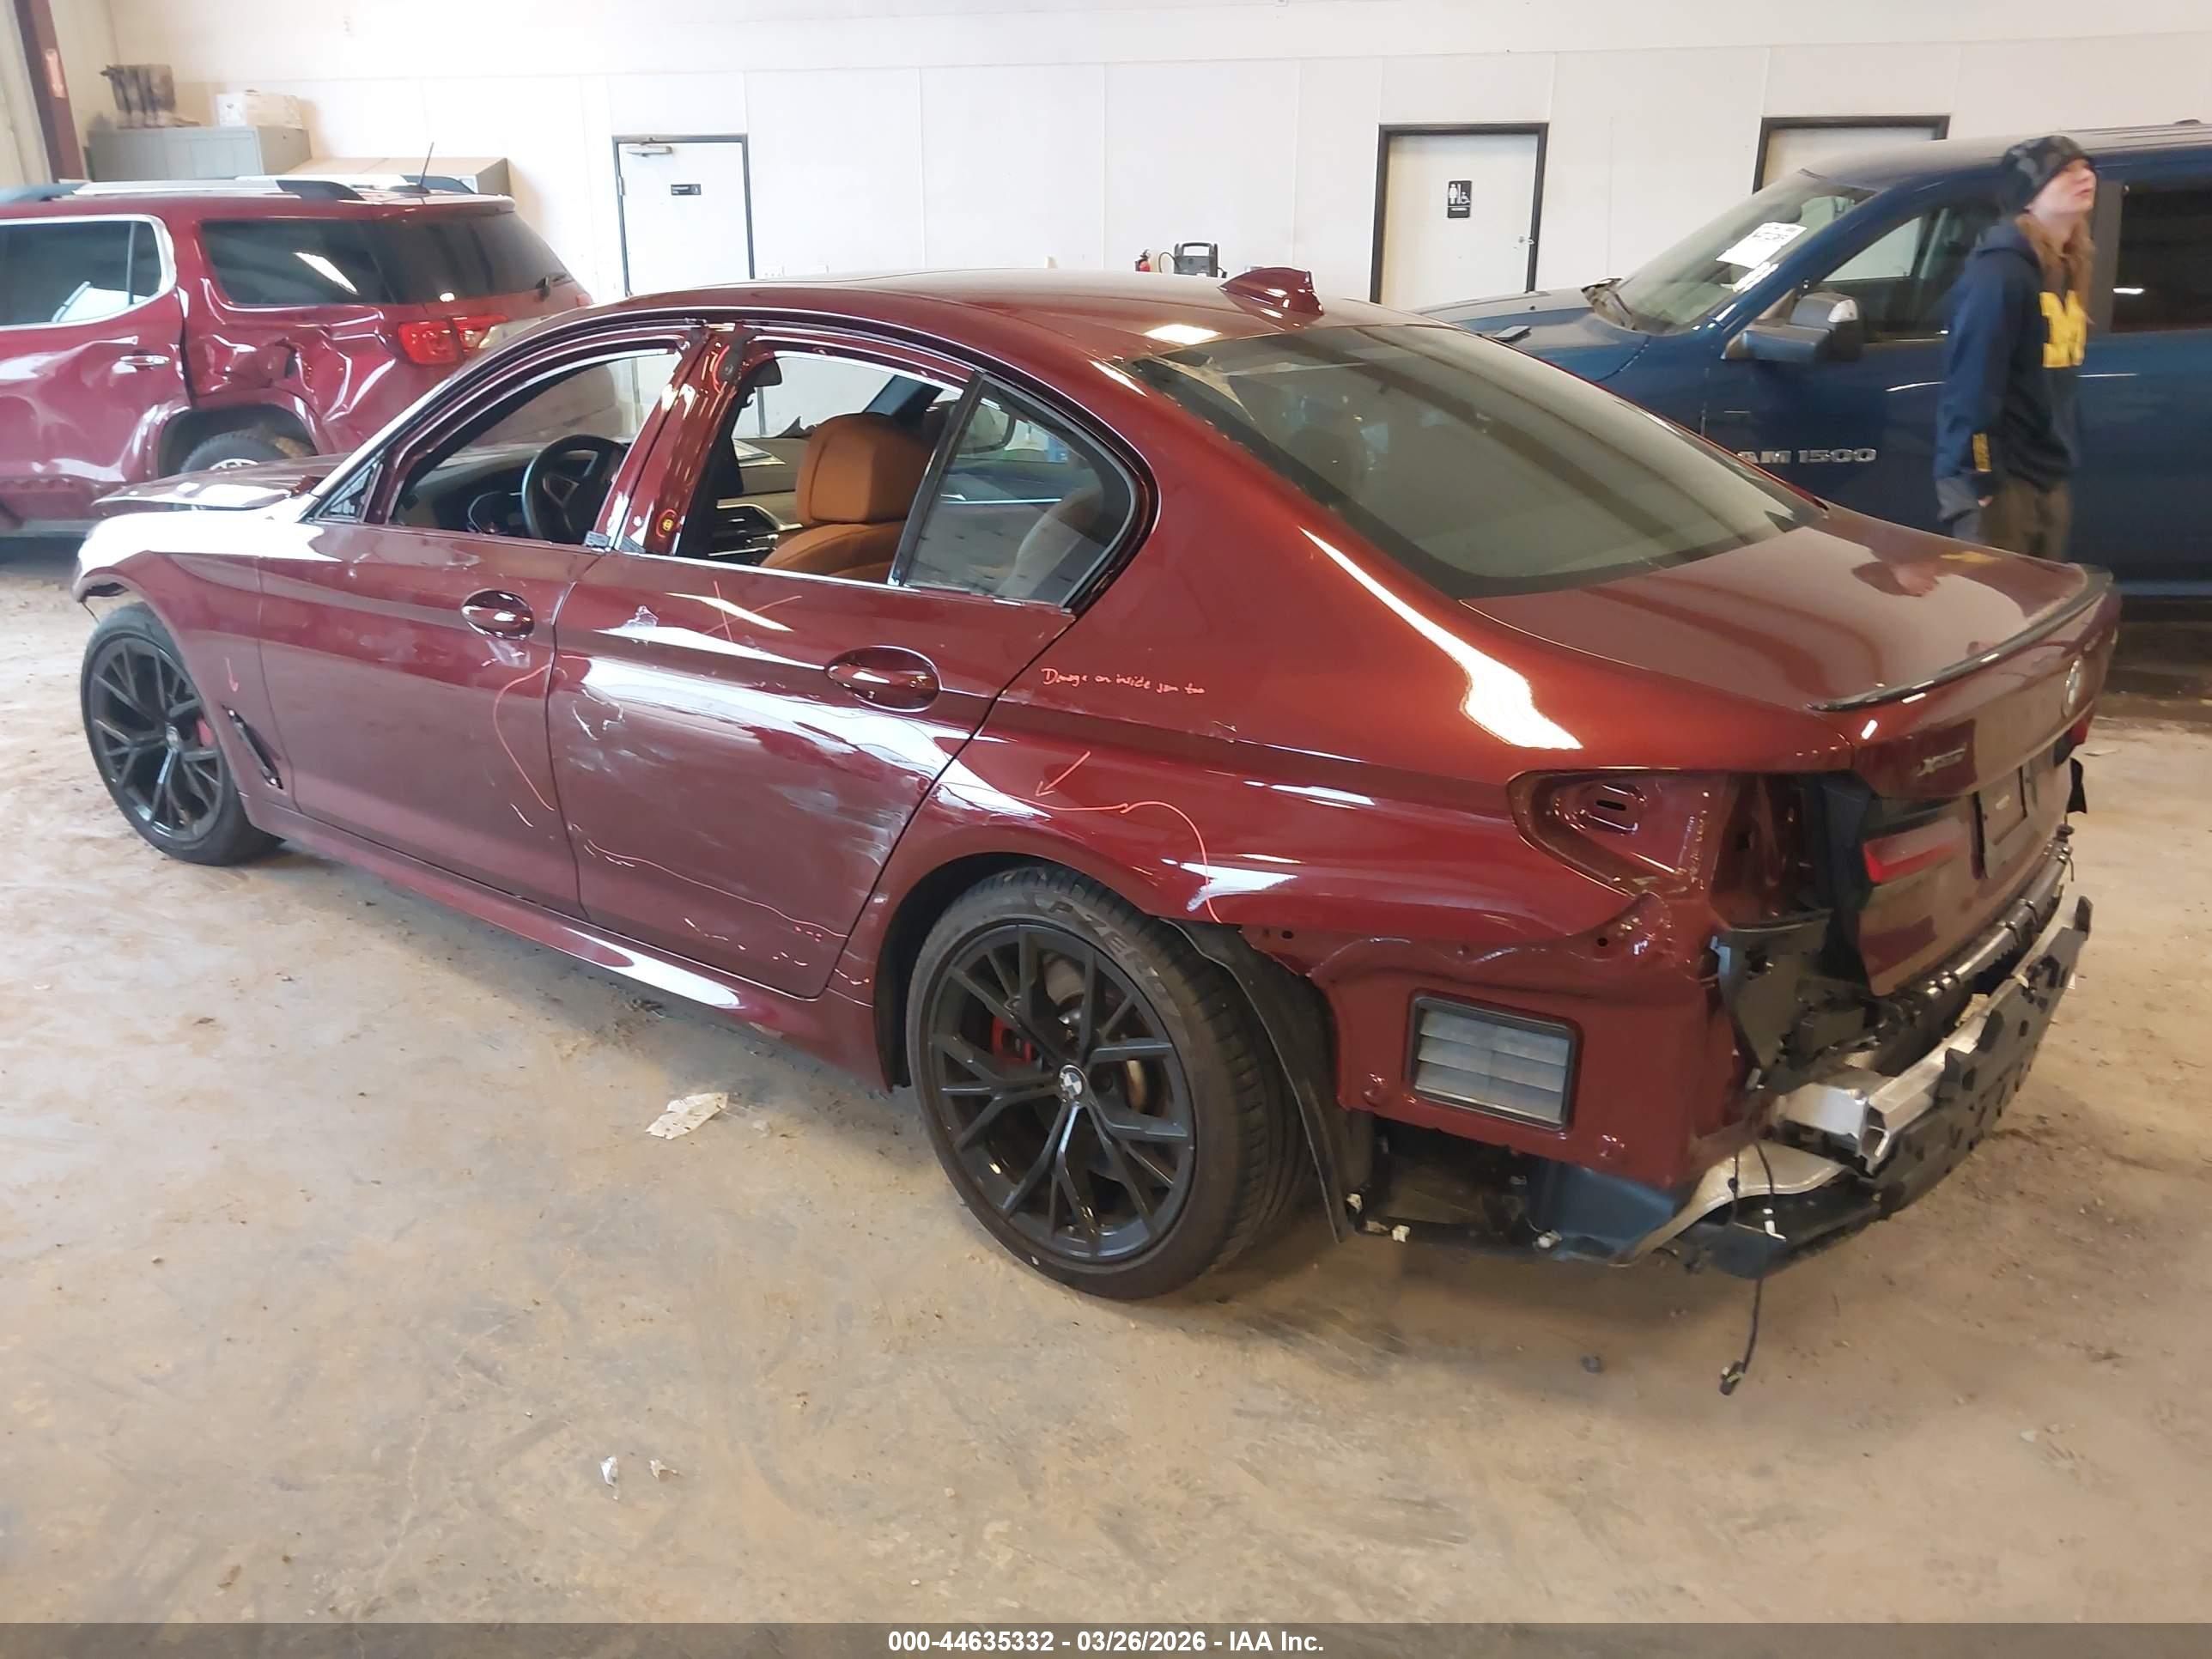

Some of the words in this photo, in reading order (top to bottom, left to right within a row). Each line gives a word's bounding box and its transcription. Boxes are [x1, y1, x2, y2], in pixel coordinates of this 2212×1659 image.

[2039, 289, 2087, 368] M
[1736, 450, 1791, 464] AM
[1797, 448, 1877, 463] 1500
[1115, 674, 1151, 689] inside
